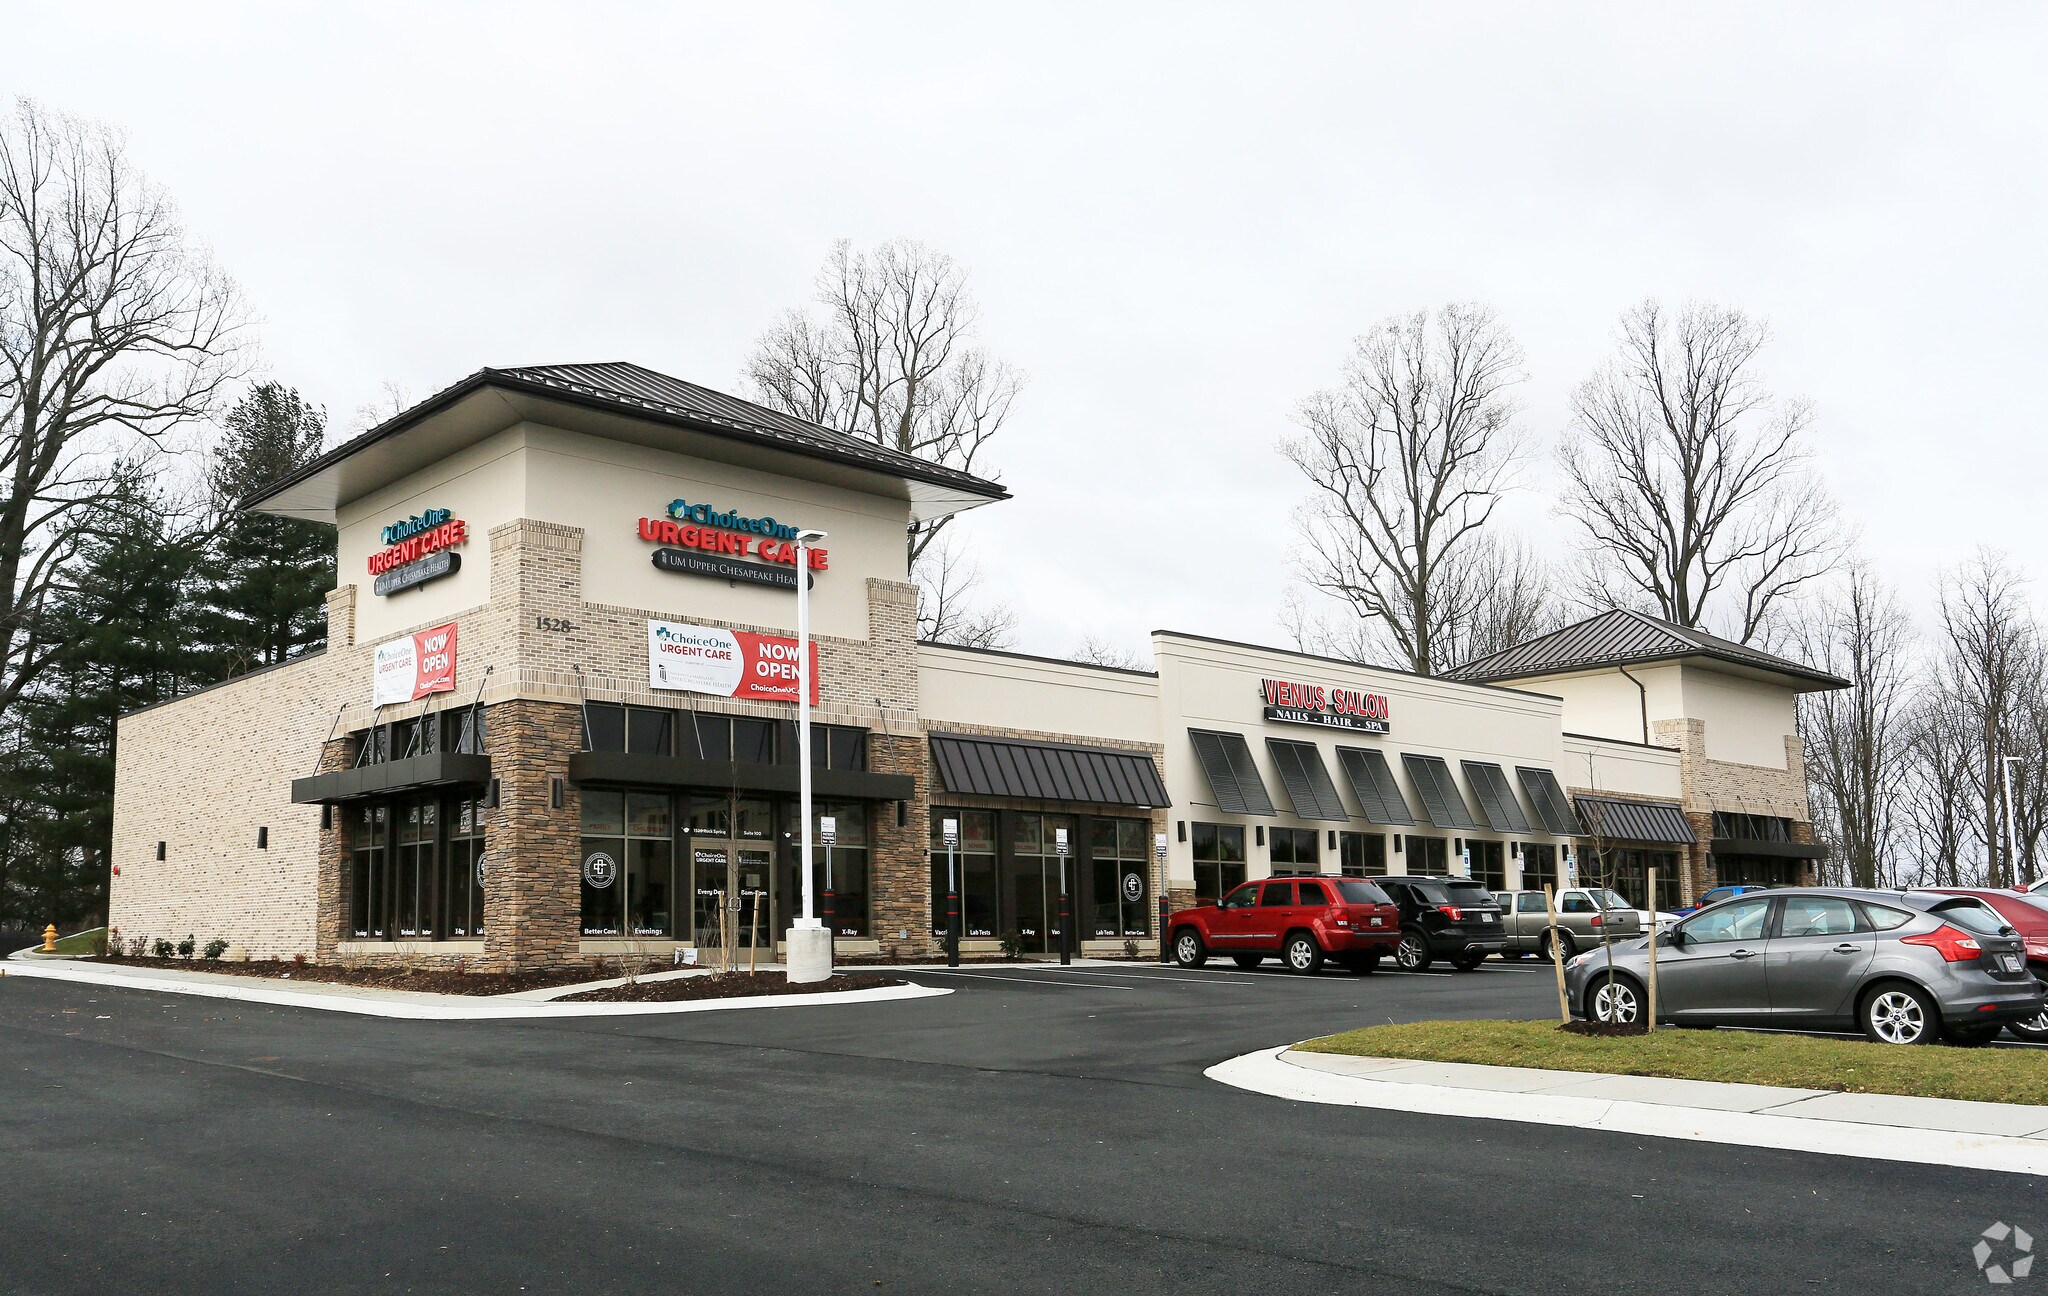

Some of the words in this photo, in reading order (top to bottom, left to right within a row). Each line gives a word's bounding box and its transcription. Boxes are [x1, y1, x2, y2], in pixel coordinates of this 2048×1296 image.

[390, 508, 450, 542] ChoiceOne
[691, 504, 800, 540] ChoiceOne
[368, 537, 420, 575] URGENT
[422, 520, 466, 553] CARE
[638, 517, 752, 557] URGENT
[670, 555, 686, 567] UM
[688, 558, 718, 573] UPPER
[719, 564, 773, 581] CHESAPEAKE
[776, 573, 799, 586] HEAL
[536, 616, 571, 633] 1528
[424, 633, 447, 654] NOW
[671, 632, 732, 649] ChoiceOne
[383, 647, 412, 661] ChoiceOne
[660, 643, 702, 657] URGENT
[705, 649, 732, 660] CARE
[759, 642, 800, 662] NOW
[379, 660, 398, 674] URGENT
[399, 657, 412, 668] CARE
[423, 652, 448, 674] OPEN
[756, 660, 800, 680] OPEN
[1262, 678, 1327, 712] VENUS
[1332, 688, 1390, 719] SALON
[1276, 709, 1309, 721] NAILS
[1323, 715, 1352, 727] HAIR
[1365, 720, 1383, 731] SPA
[634, 928, 662, 936] Evenings
